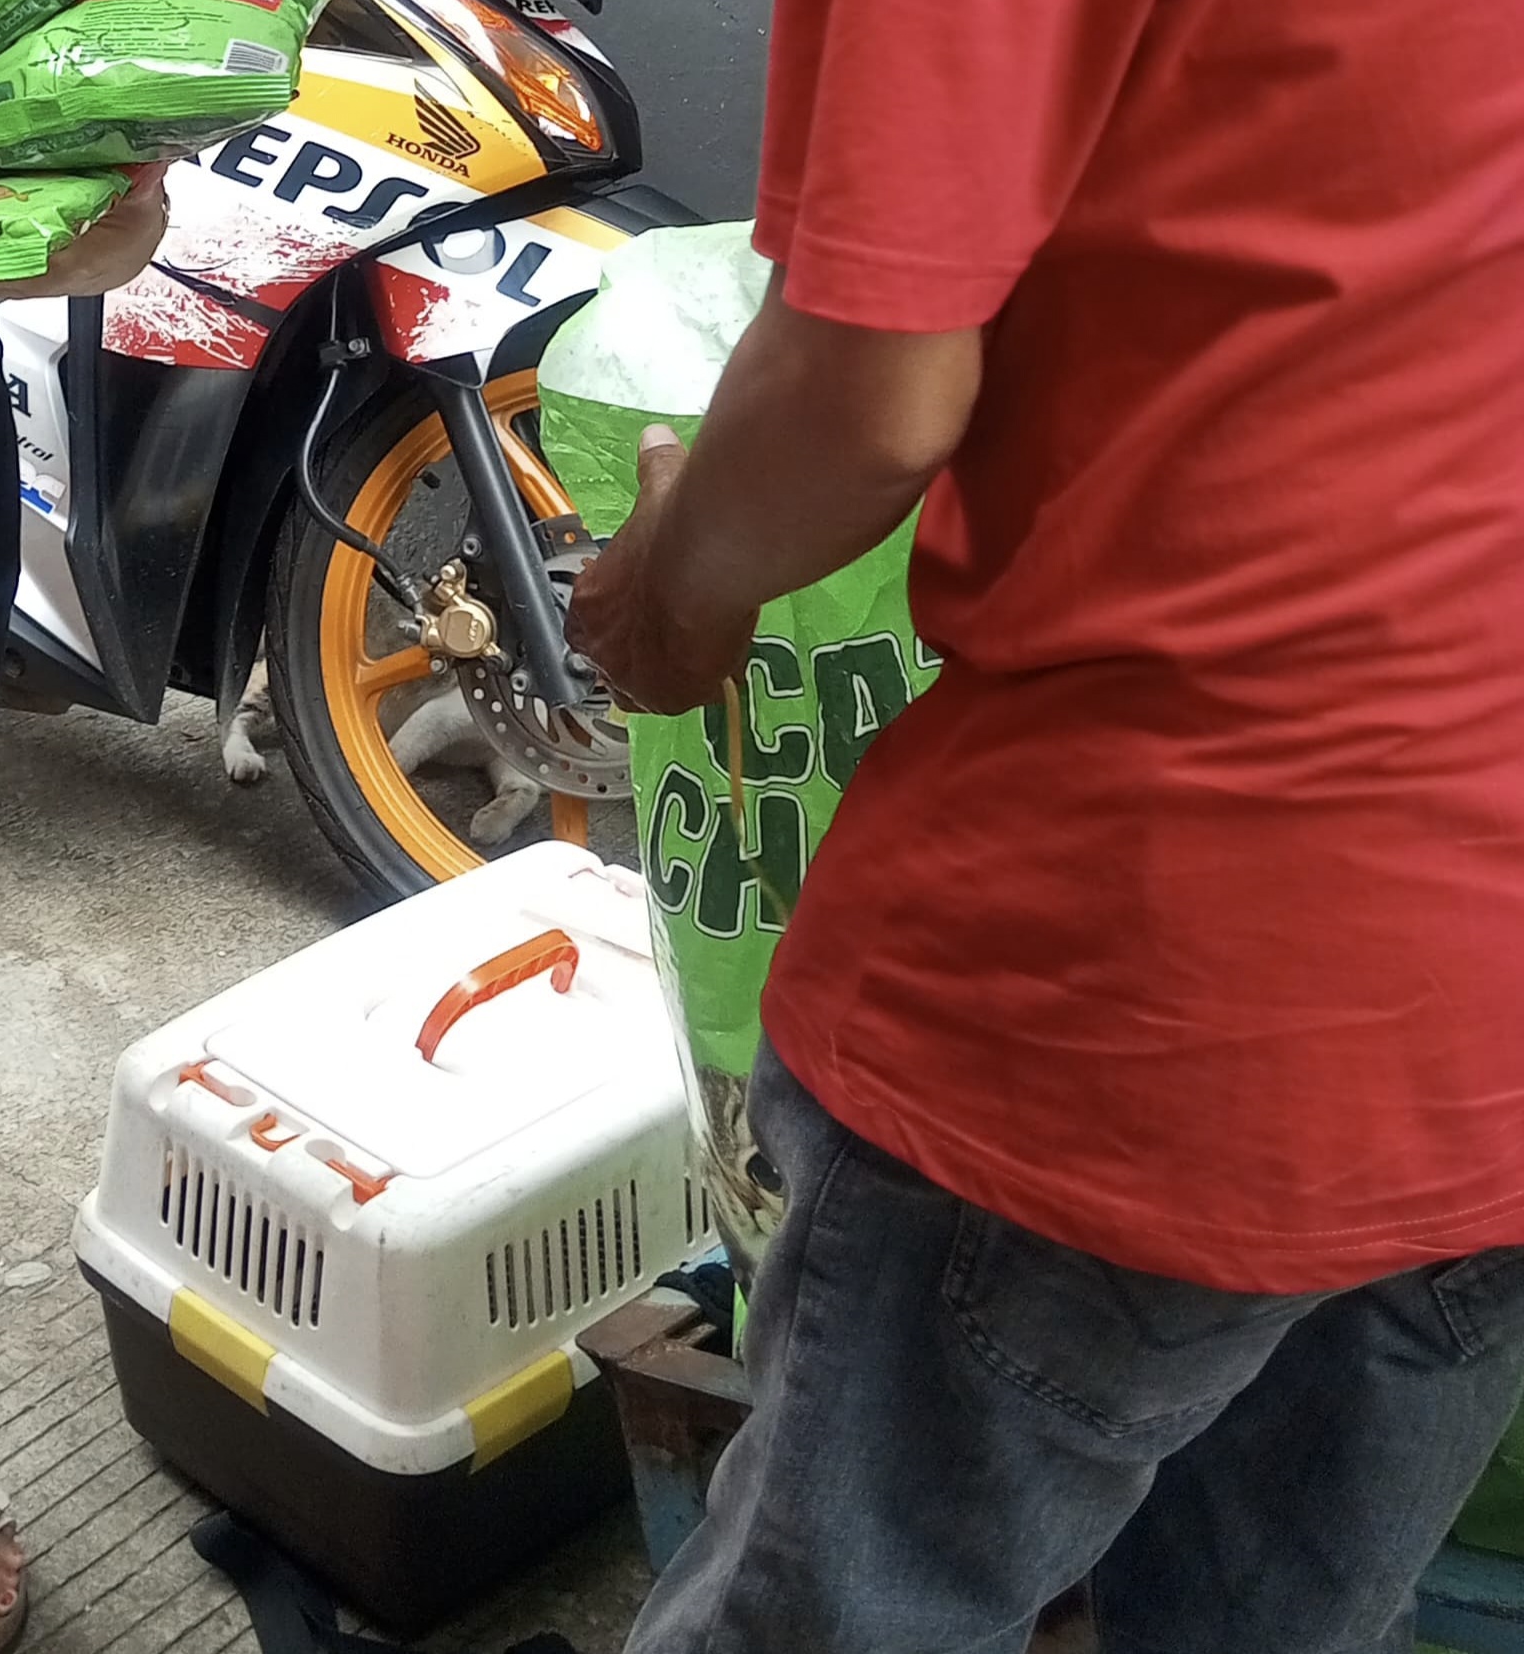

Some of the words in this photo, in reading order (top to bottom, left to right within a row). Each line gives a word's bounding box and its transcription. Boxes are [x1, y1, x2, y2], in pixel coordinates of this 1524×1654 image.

[385, 132, 470, 178] HONDA
[180, 123, 552, 307] EPSOL
[17, 436, 54, 462] trol
